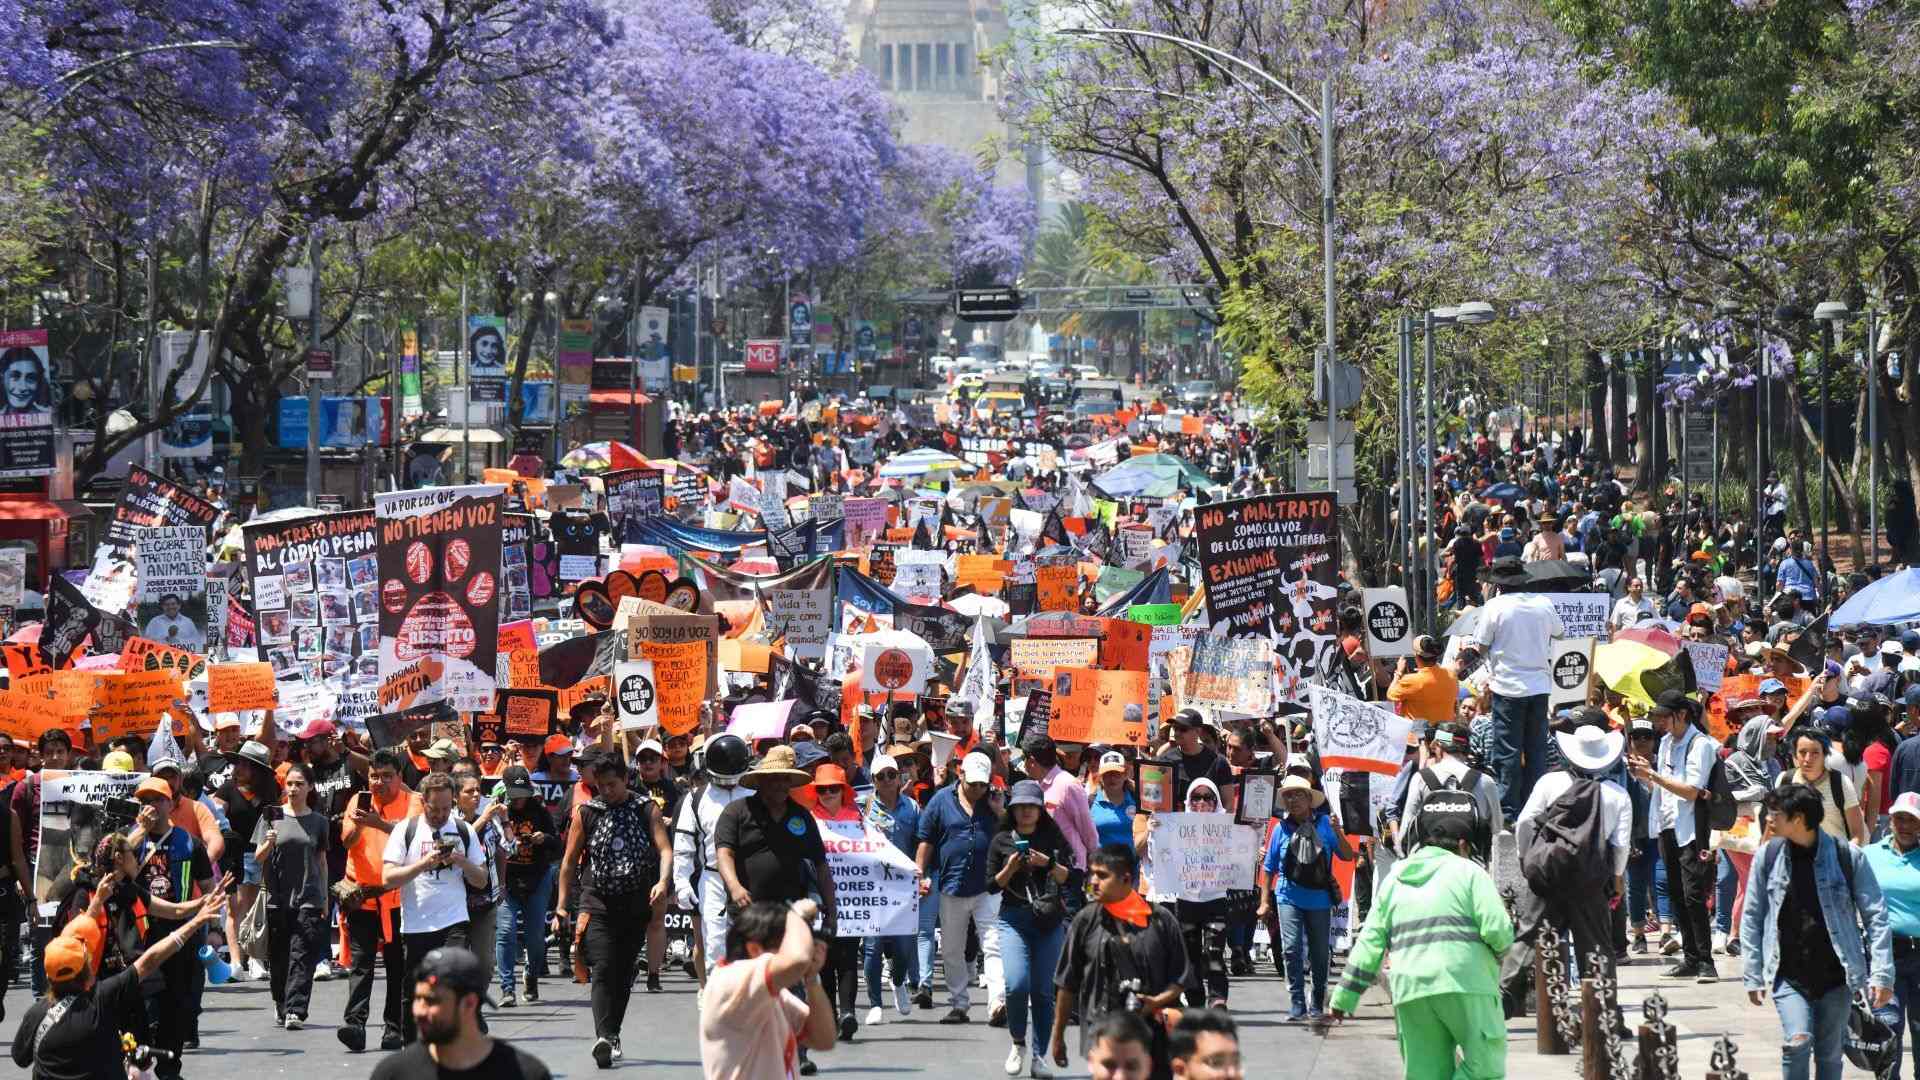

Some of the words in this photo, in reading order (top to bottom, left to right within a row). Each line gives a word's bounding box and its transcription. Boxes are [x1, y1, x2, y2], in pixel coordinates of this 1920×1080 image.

[747, 346, 776, 362] MB
[384, 503, 398, 515] VA
[399, 499, 417, 512] POR
[419, 496, 435, 508] LOS
[437, 490, 456, 503] QUE
[1202, 510, 1224, 530] NO
[1243, 499, 1330, 524] MALTRATO
[383, 519, 404, 545] NO
[405, 505, 464, 539] TIENEN
[466, 502, 496, 528] VOZ
[1234, 522, 1268, 537] SOMOS
[1268, 522, 1281, 533] LA
[1282, 521, 1302, 533] VOZ
[138, 527, 162, 541] QUE
[163, 527, 177, 539] LA
[180, 527, 205, 539] VIDA
[255, 521, 326, 553] MALTRATO
[139, 543, 153, 553] TE
[154, 539, 187, 553] COBRE
[189, 539, 203, 550] TU
[257, 553, 276, 573] AL
[331, 531, 378, 555] PENA
[1210, 541, 1224, 554] DE
[1226, 540, 1246, 552] LOS
[1280, 535, 1293, 547] LA
[139, 552, 173, 564] TRATO
[185, 550, 204, 562] LOS
[1208, 548, 1278, 582] EXIGIMOS
[146, 561, 207, 577] ANIMALES
[1392, 617, 1404, 627] SU
[635, 627, 649, 640] YO
[652, 626, 673, 639] SOY
[673, 626, 686, 638] LA
[687, 627, 711, 638] VOZ
[1380, 627, 1400, 639] VOZ
[382, 674, 432, 706] JUSTICIA
[639, 688, 650, 699] SU
[629, 700, 646, 712] VOZ
[79, 783, 90, 793] AL
[1423, 801, 1472, 814] adidas
